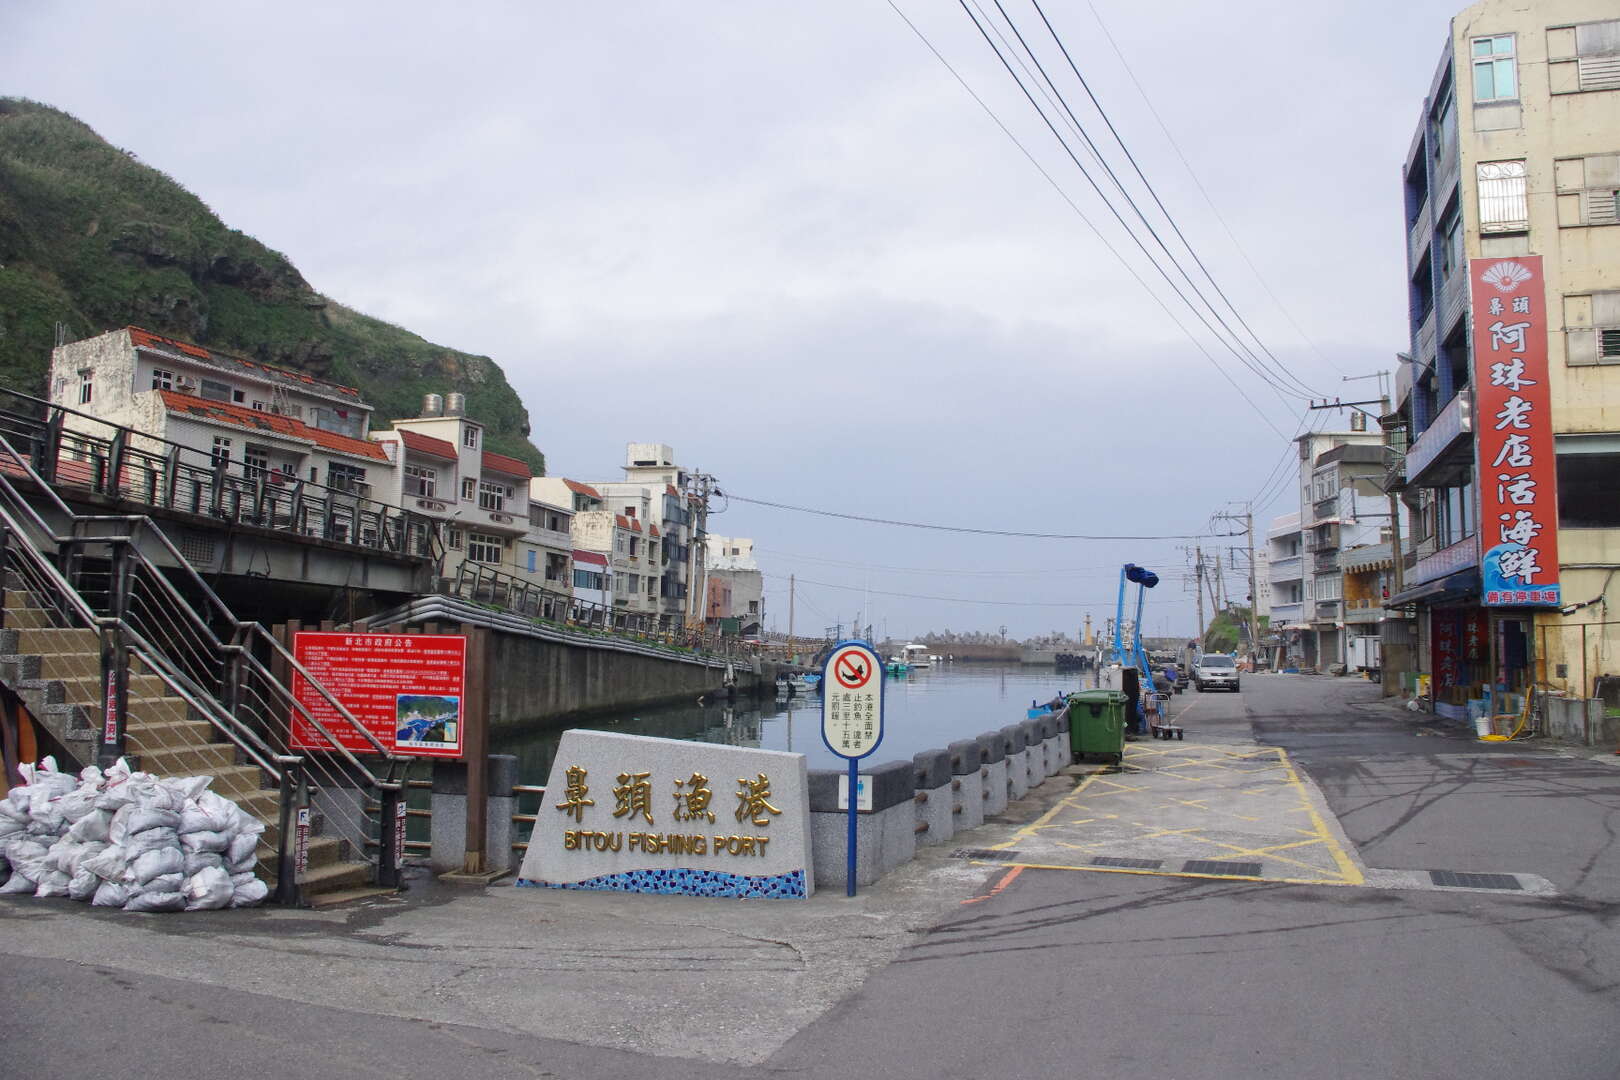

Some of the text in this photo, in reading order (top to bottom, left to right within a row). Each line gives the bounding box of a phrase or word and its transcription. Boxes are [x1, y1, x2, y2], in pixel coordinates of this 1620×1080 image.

[1488, 296, 1531, 316] 鼻頭
[1487, 321, 1544, 585] 阿珠老店活海鮮
[1487, 591, 1557, 603] 備有停車場
[345, 637, 413, 647] 新北市政府公告
[864, 693, 873, 740] 本港全面禁
[556, 765, 782, 826] 鼻頭漁港
[564, 830, 770, 857] BITOU FISHING PORT
